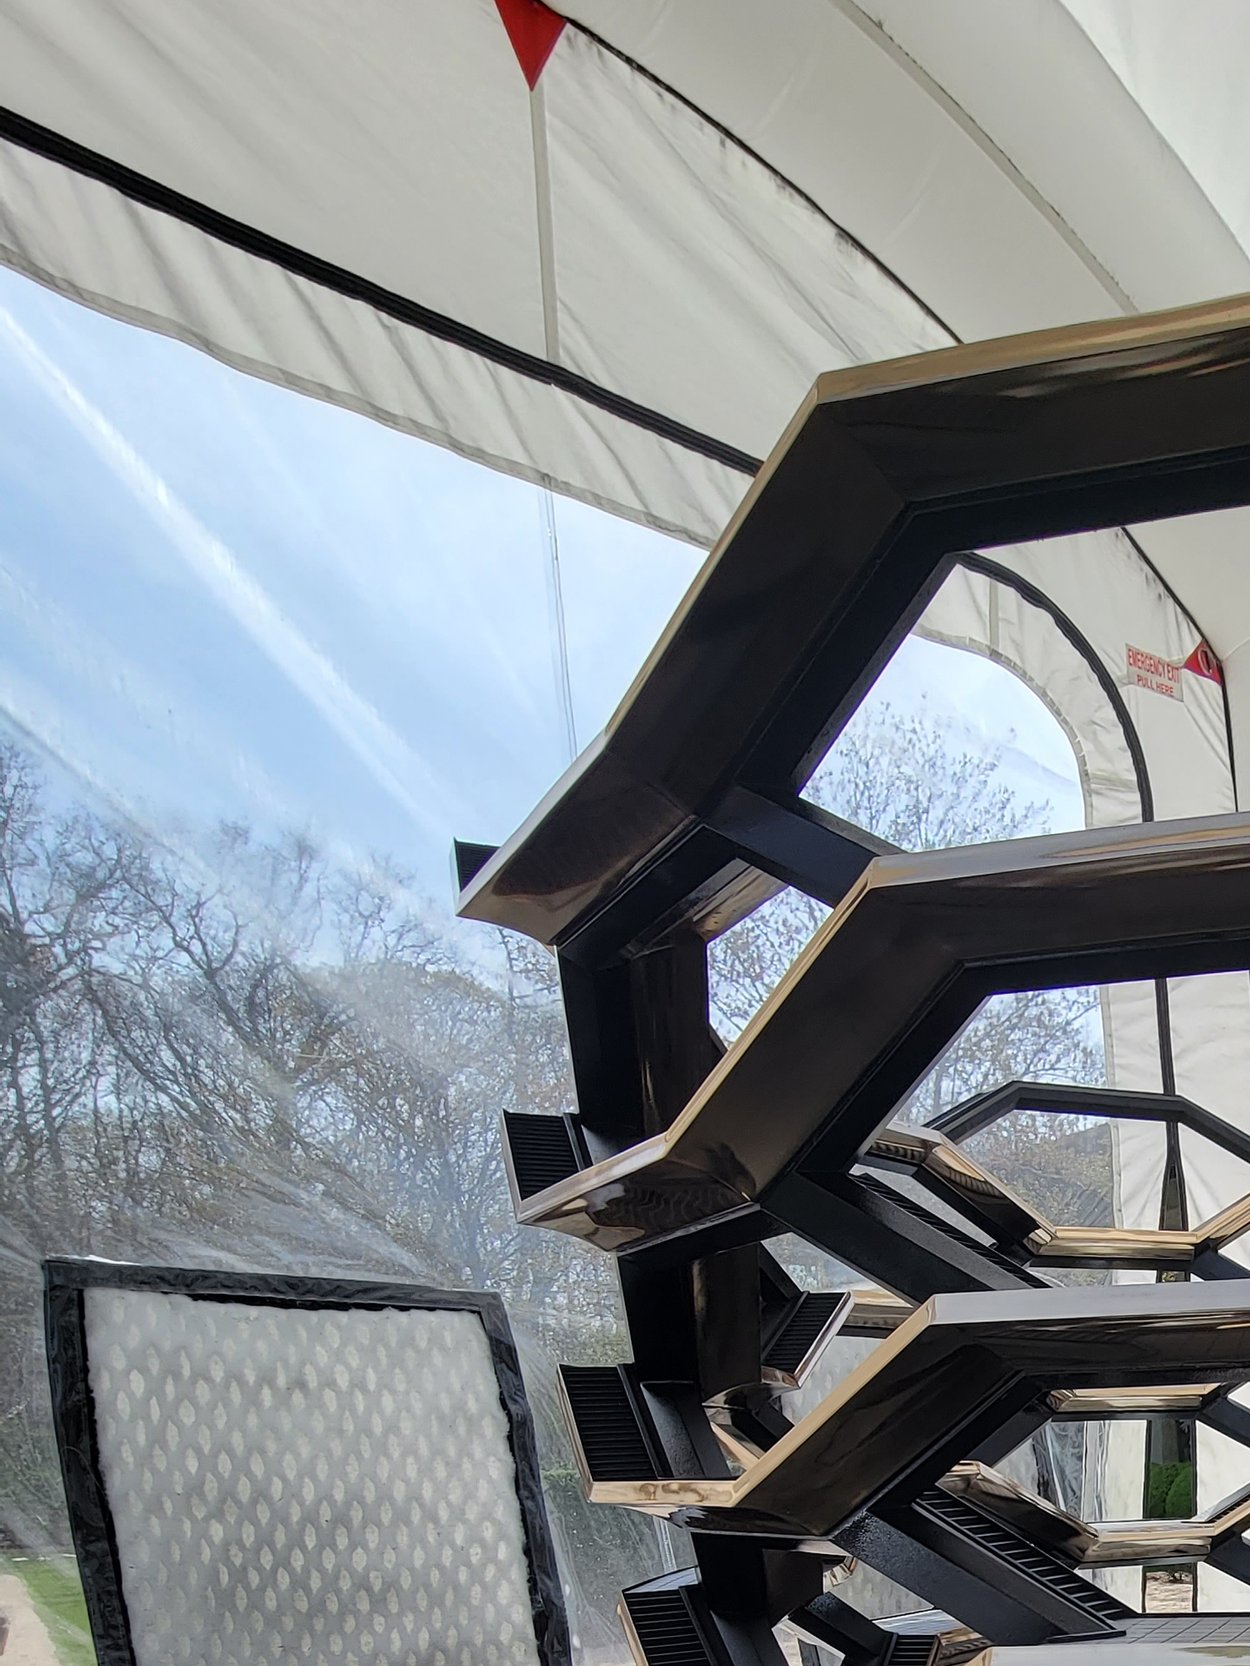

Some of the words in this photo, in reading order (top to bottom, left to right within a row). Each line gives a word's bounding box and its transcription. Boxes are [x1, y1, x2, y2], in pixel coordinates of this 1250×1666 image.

[1128, 648, 1165, 679] EMERGENCY
[1166, 662, 1180, 684] EXIT
[1136, 674, 1155, 691] PULL
[1156, 681, 1174, 697] HERE
